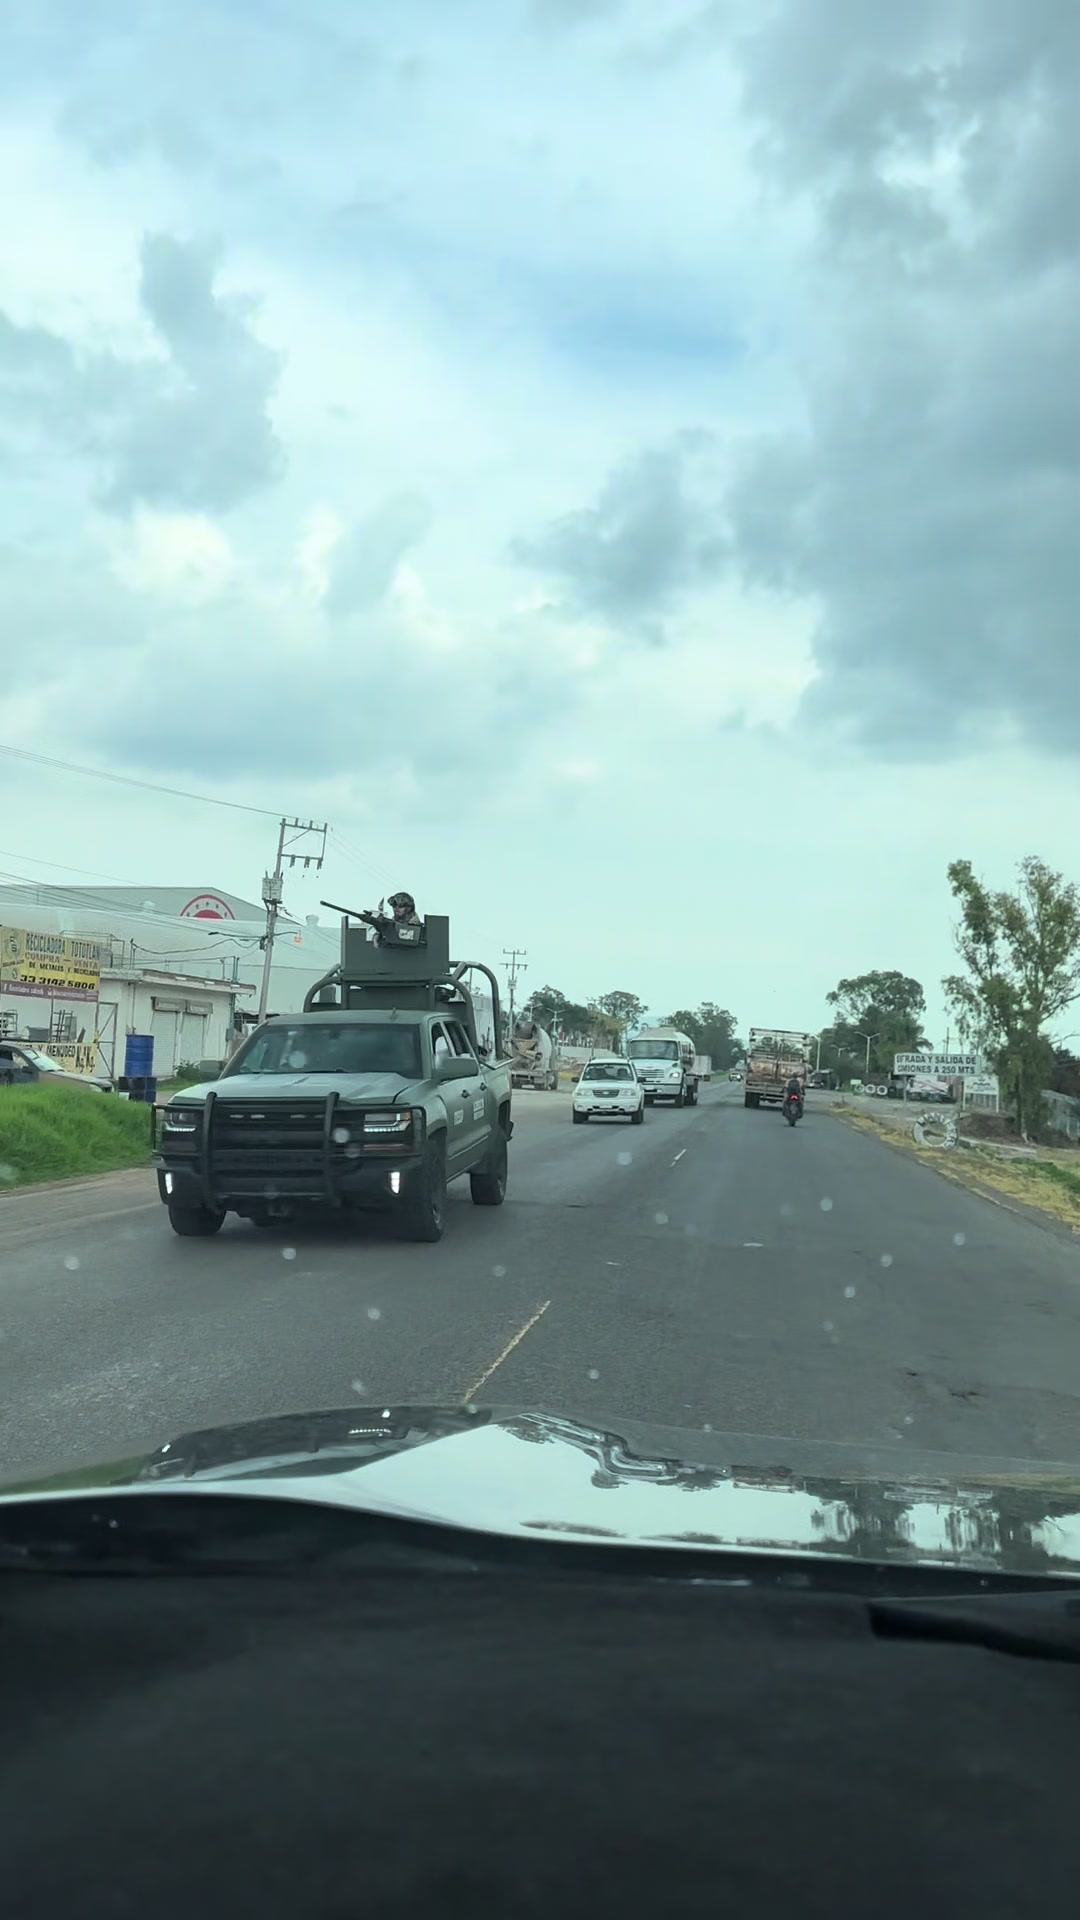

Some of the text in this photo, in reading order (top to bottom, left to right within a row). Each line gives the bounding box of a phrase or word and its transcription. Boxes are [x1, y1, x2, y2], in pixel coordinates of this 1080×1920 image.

[26, 933, 65, 955] RECICLADORA
[25, 952, 60, 963] COMPRA
[74, 960, 98, 969] VENTA
[20, 974, 36, 983] 33
[38, 976, 65, 987] 3142
[928, 1055, 933, 1063] Y
[935, 1056, 964, 1064] SALIDA
[966, 1056, 977, 1065] DE
[942, 1066, 956, 1074] 250
[958, 1066, 976, 1074] MTS
